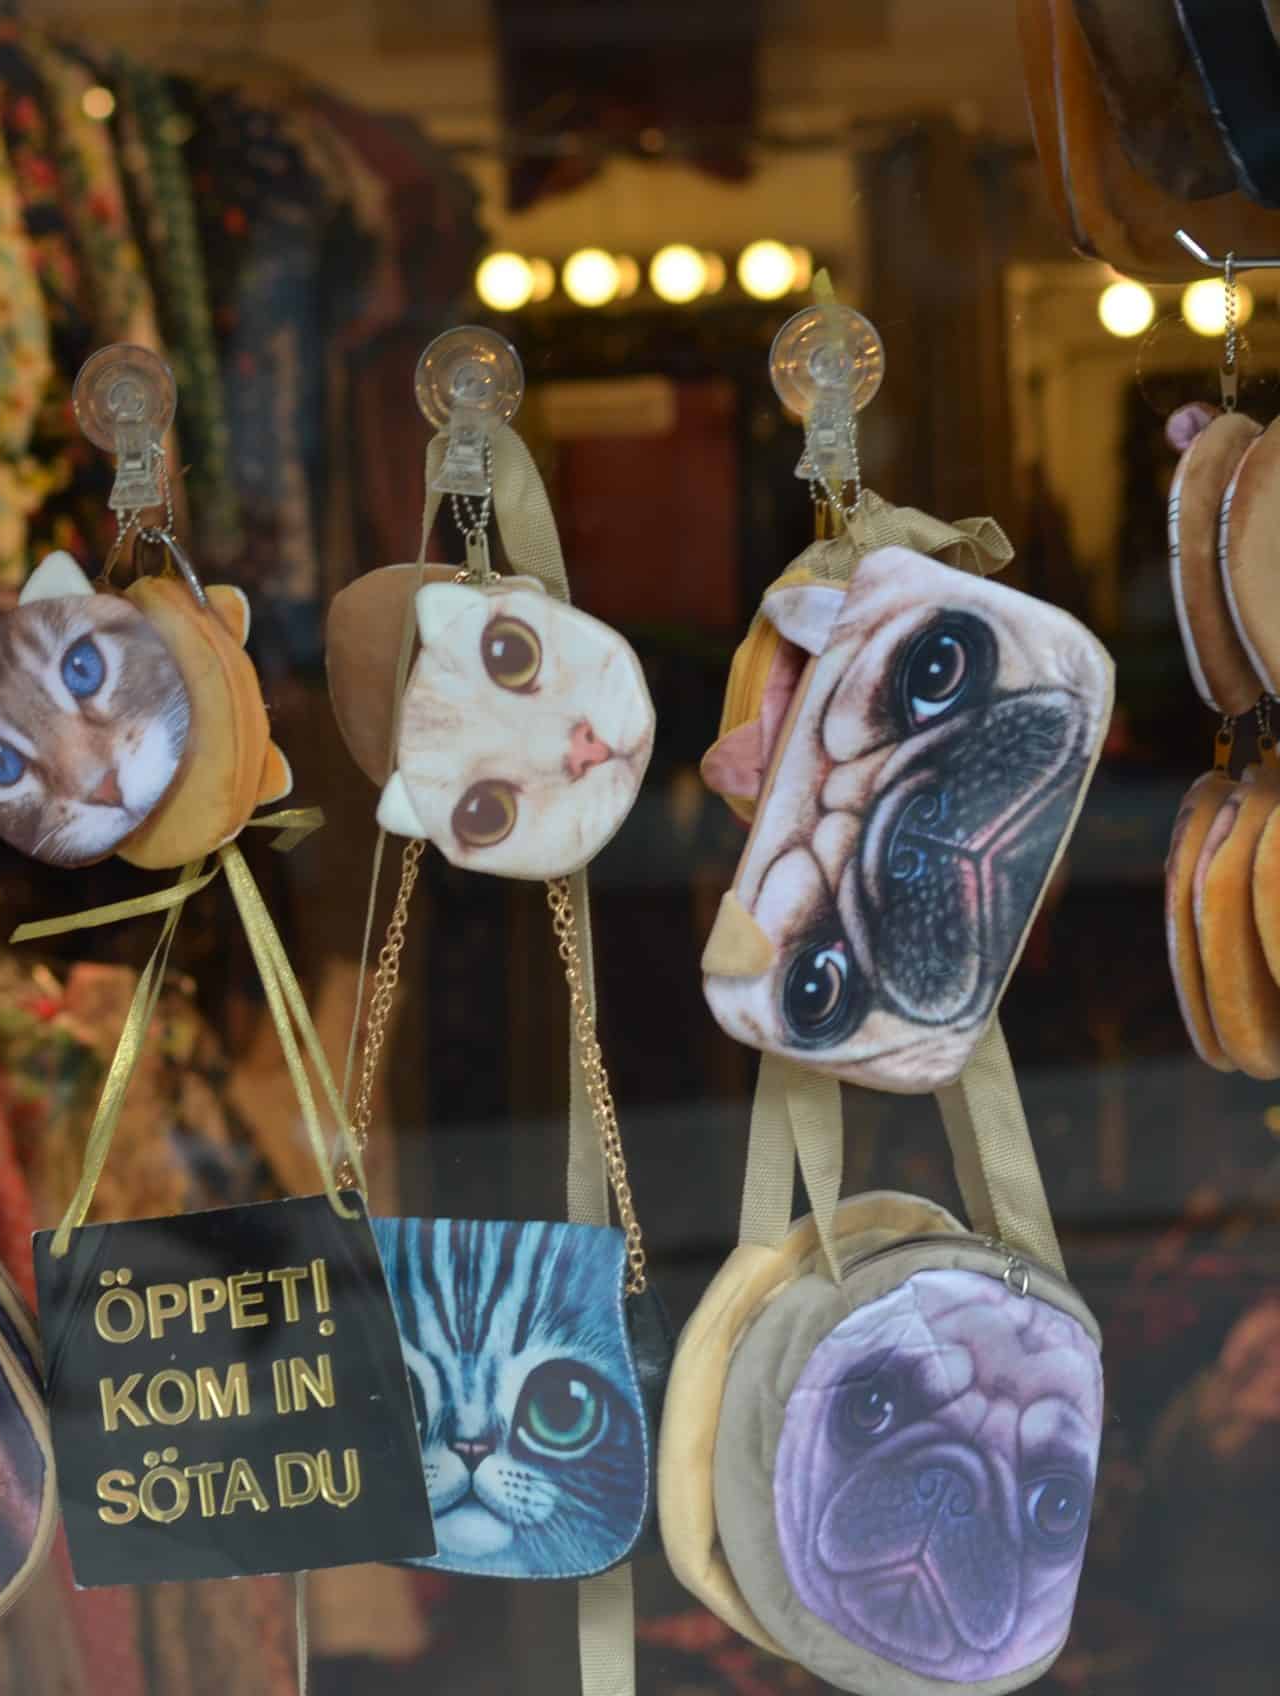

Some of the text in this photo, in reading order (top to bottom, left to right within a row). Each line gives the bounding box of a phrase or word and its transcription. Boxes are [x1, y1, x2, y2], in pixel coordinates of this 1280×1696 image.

[94, 1258, 335, 1344] ÖPPET!
[98, 1354, 336, 1432] KOM IN
[95, 1446, 361, 1525] SÖTA DU
